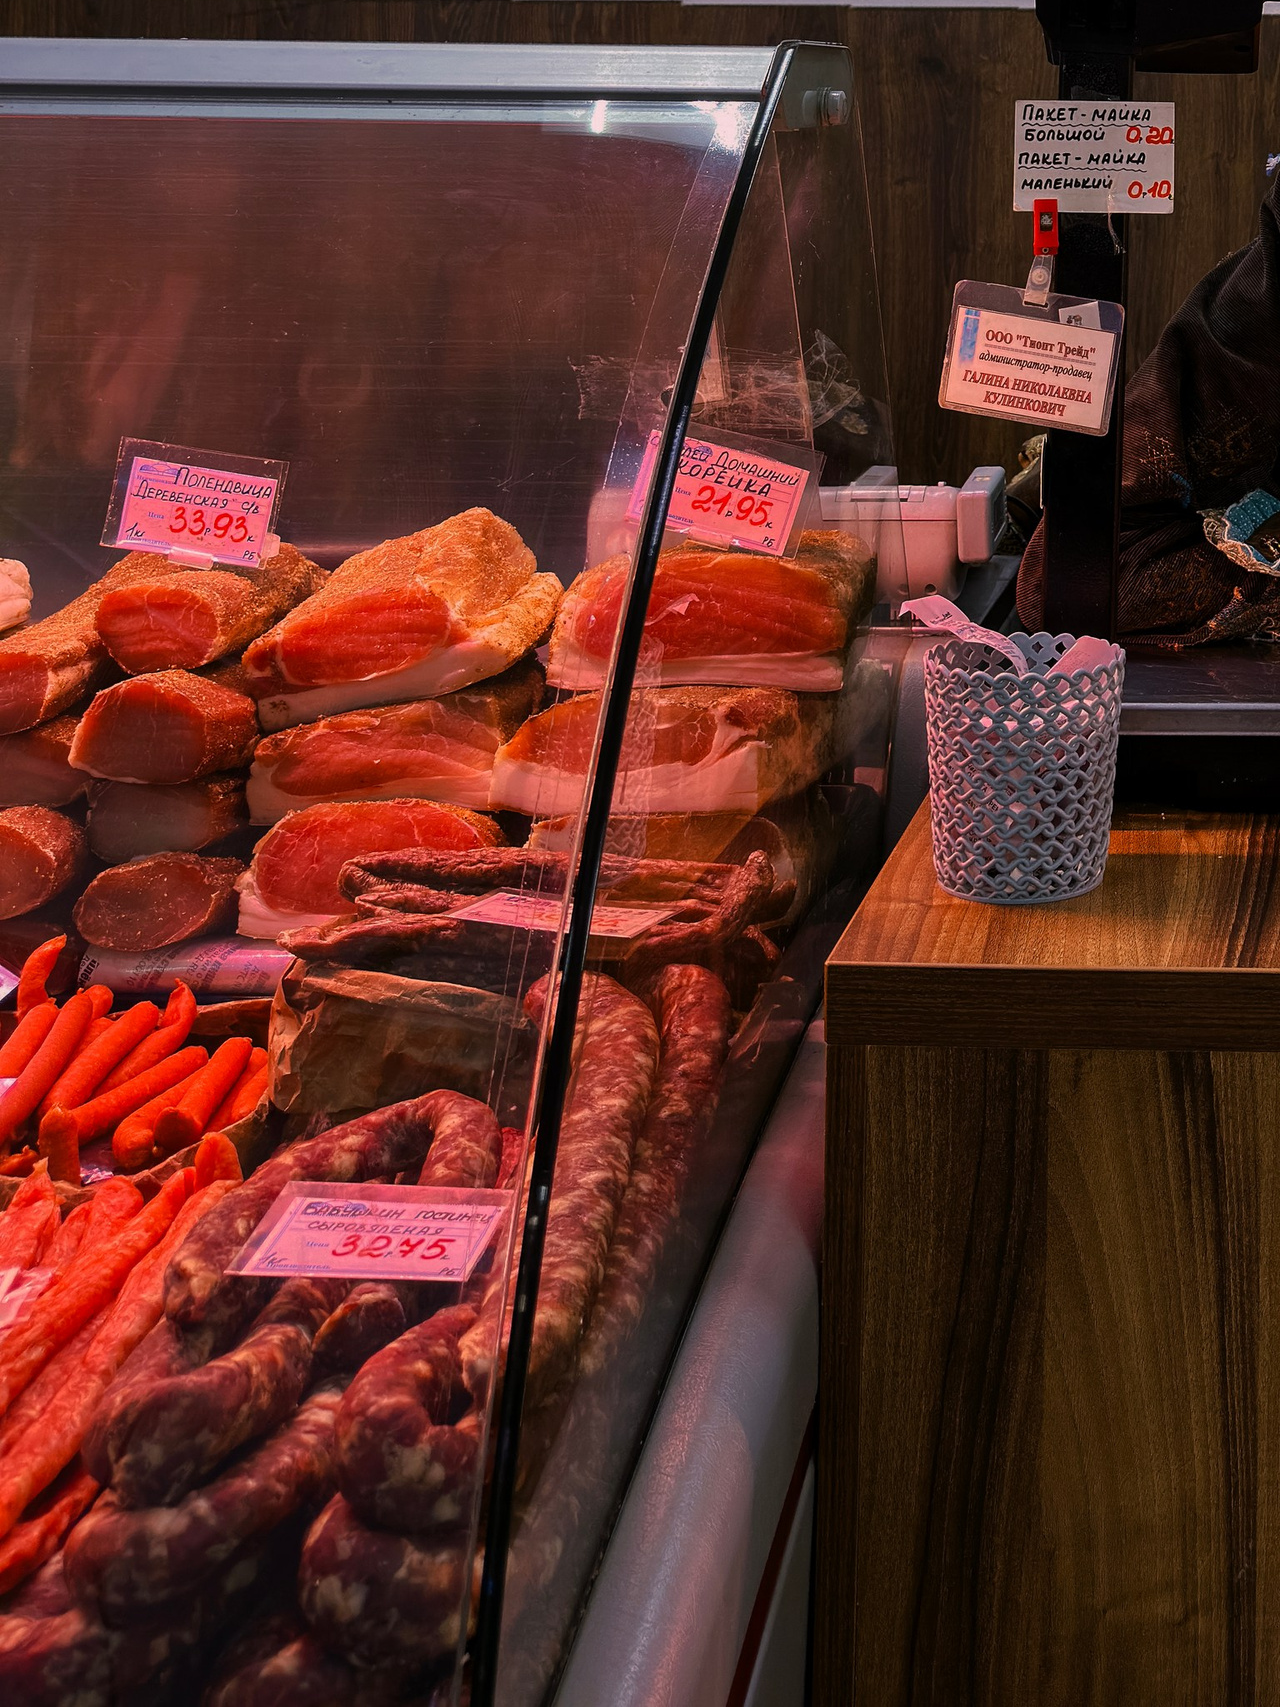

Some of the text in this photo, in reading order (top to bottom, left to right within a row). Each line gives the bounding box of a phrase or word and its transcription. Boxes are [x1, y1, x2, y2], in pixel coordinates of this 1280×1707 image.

[985, 329, 1014, 345] ООО
[1057, 341, 1096, 360] Трейд"
[978, 350, 1093, 382] администратор-продавец
[962, 369, 1093, 404] ГАЛИНА НИКОЛАЕВНА
[983, 390, 1067, 417] КУЛИНКОВИЧ
